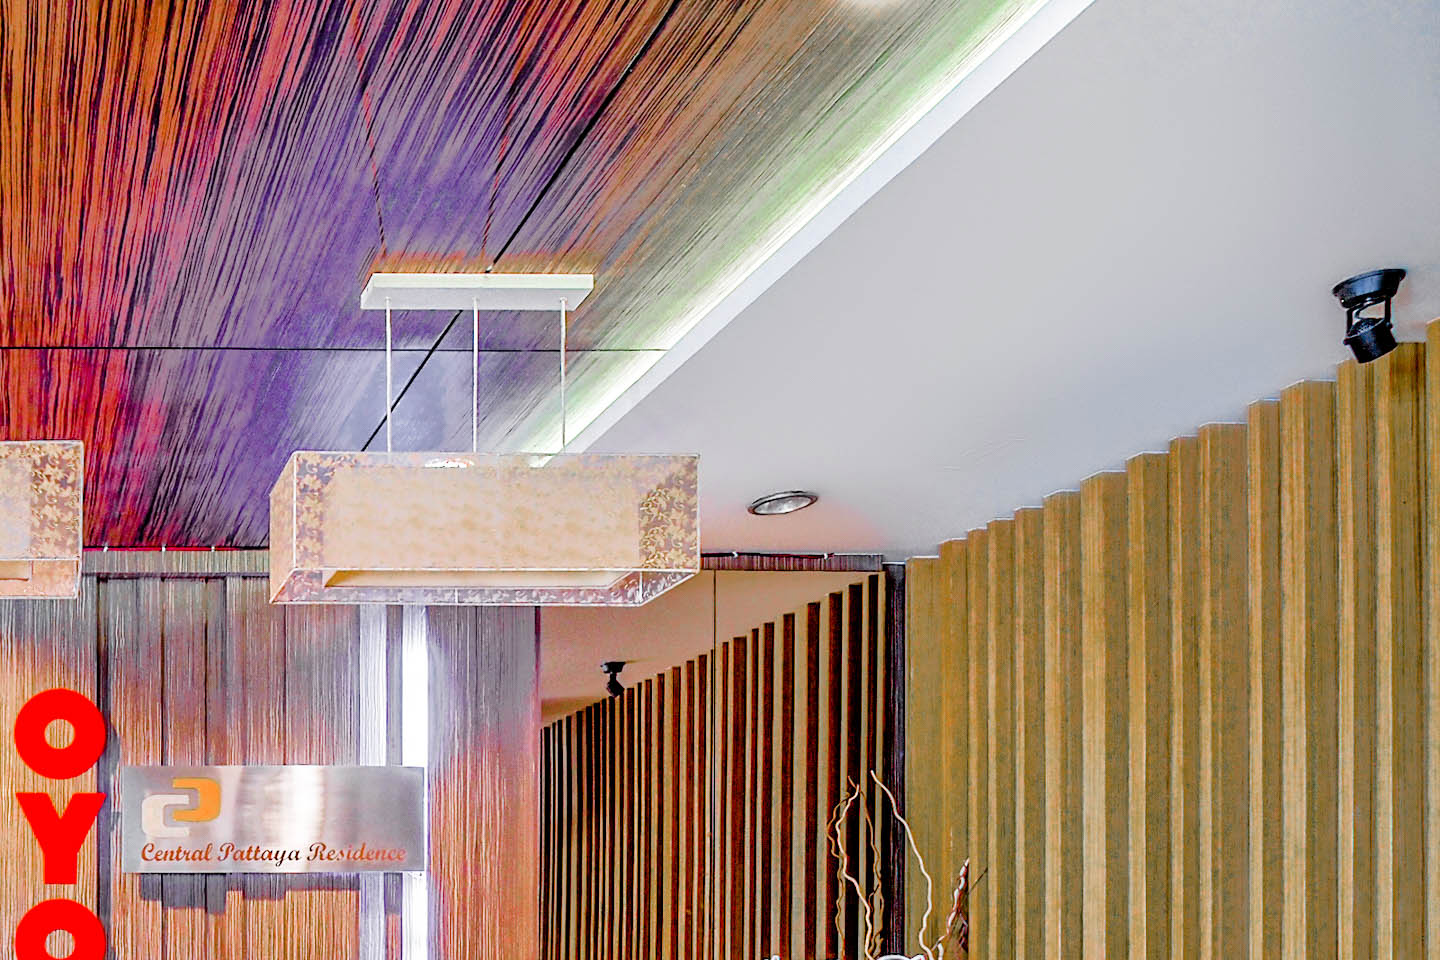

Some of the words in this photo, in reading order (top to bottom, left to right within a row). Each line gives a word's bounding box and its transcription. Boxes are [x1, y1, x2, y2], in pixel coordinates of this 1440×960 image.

[140, 842, 213, 862] Central
[216, 842, 301, 867] Pattaya
[306, 841, 407, 862] Residence
